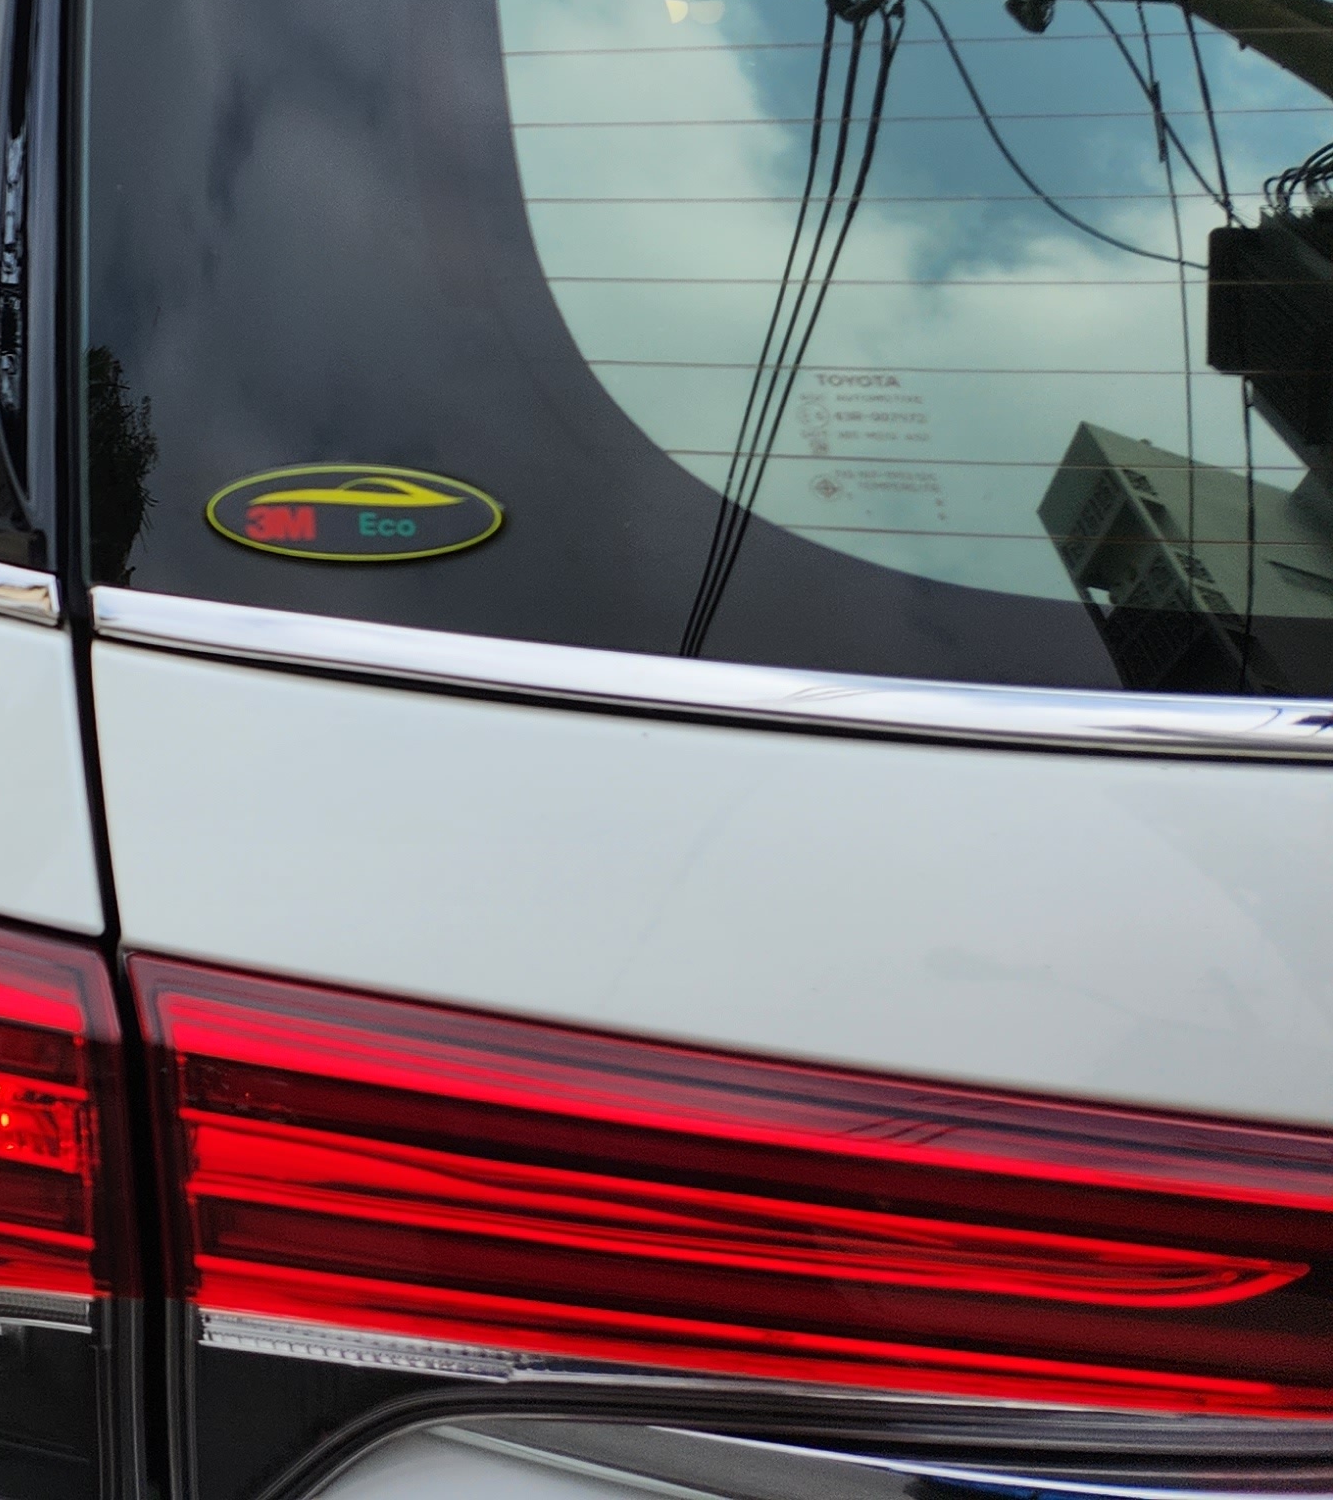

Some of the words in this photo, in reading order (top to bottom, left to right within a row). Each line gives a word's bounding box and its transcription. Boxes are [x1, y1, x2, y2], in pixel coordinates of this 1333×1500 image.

[816, 373, 901, 388] TOYOTA
[245, 505, 317, 542] 3M
[359, 511, 417, 538] Eco
